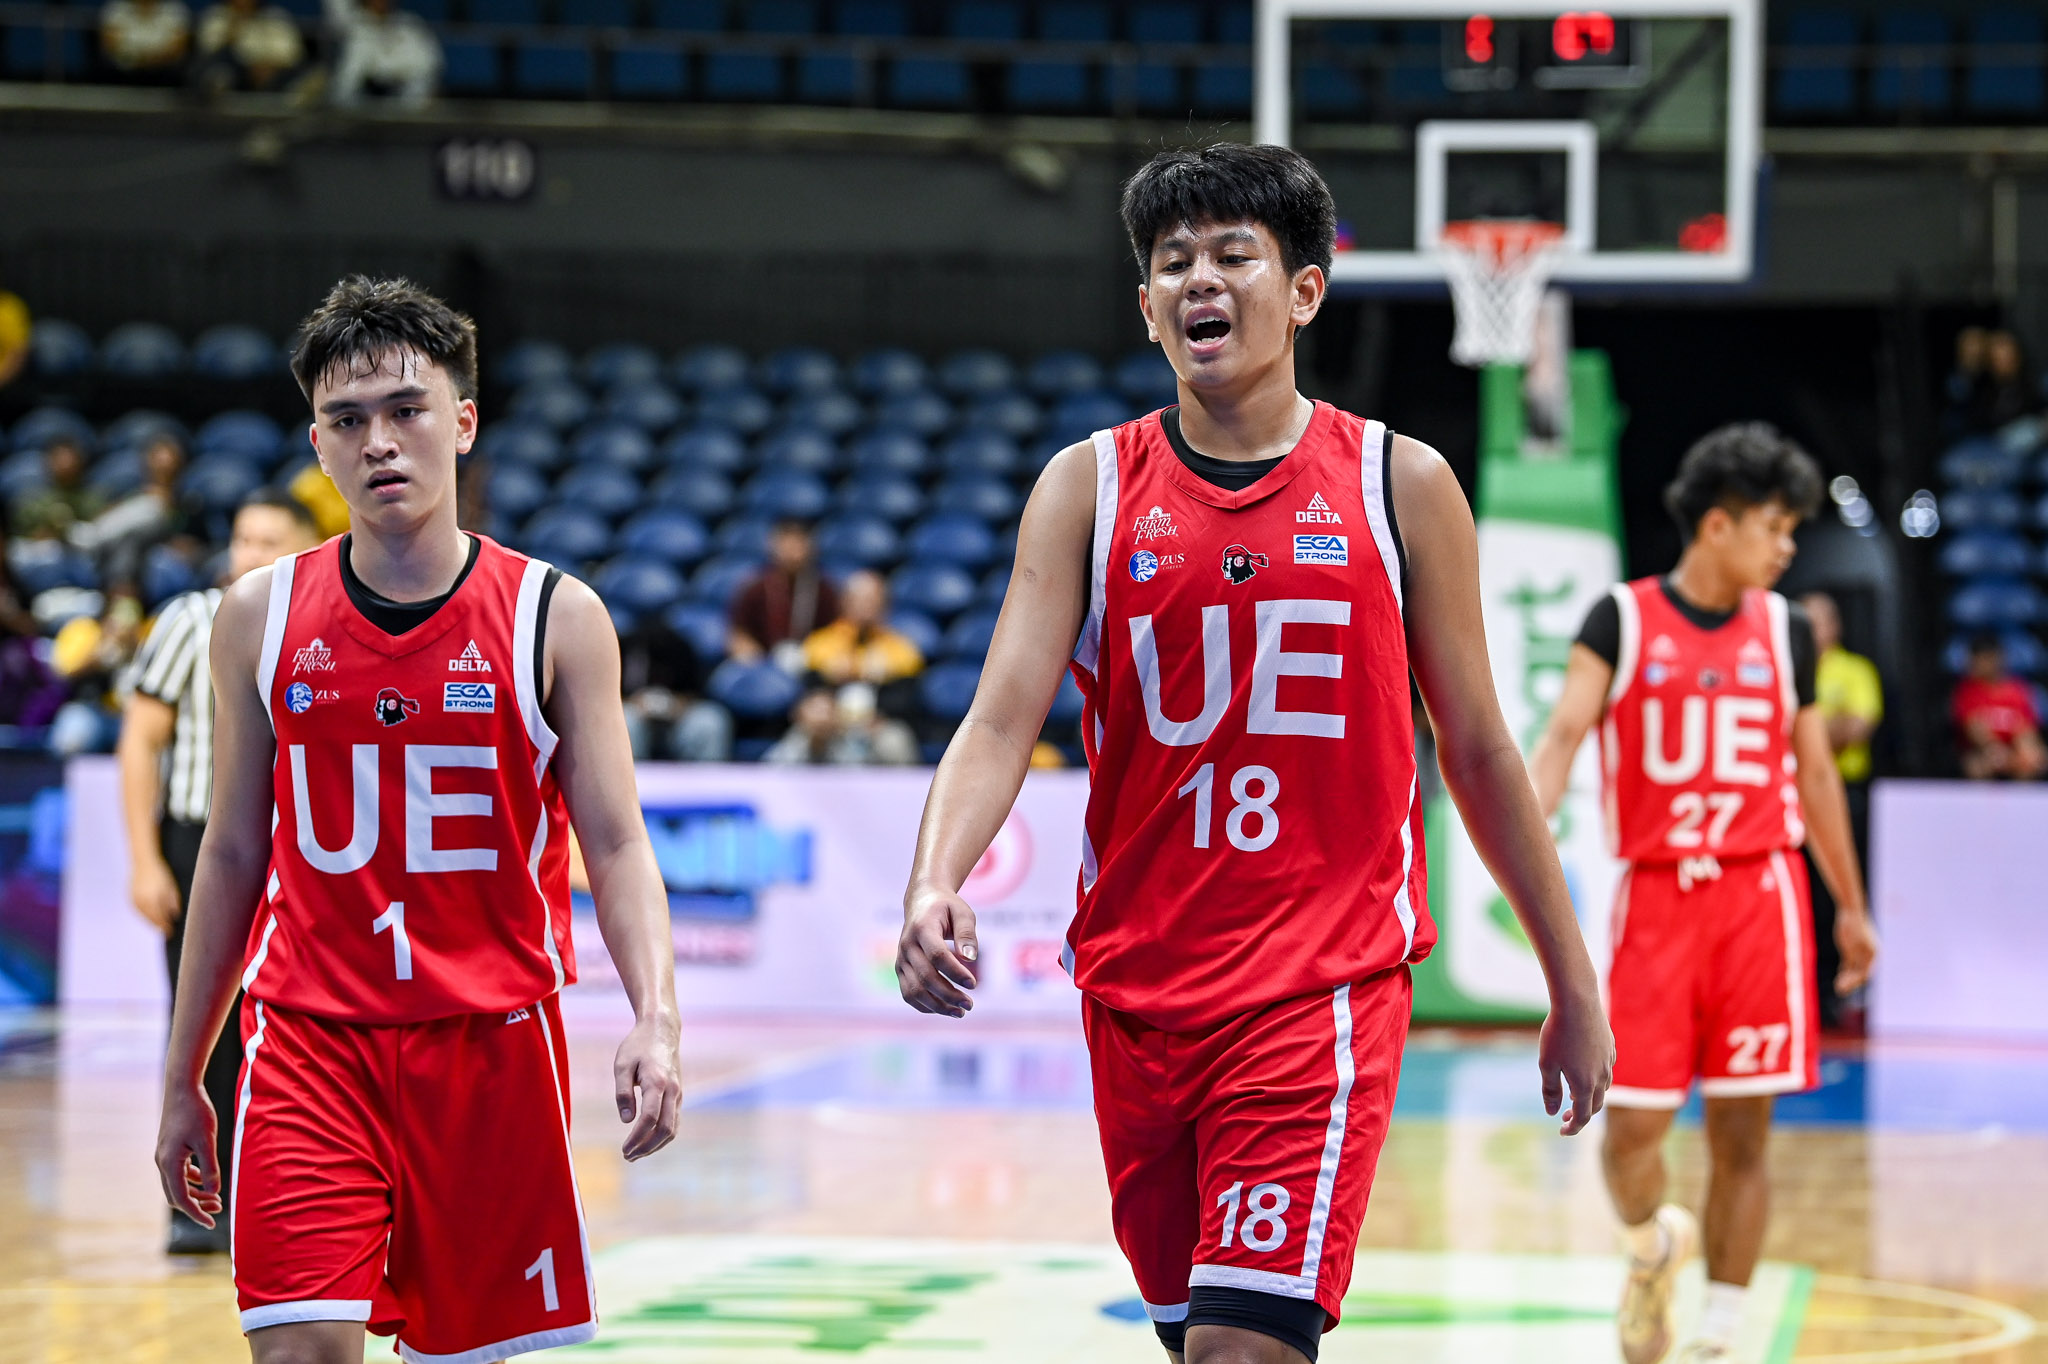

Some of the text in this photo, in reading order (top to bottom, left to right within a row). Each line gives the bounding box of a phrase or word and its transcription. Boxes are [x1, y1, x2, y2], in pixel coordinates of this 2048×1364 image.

[1295, 511, 1343, 524] DELTA
[1296, 536, 1346, 551] SGA
[1160, 553, 1185, 566] ZUS
[1296, 552, 1347, 561] STRONG
[446, 684, 492, 698] SGA
[448, 659, 492, 672] DELTA
[1129, 600, 1351, 746] UE
[315, 690, 340, 699] ZUS
[445, 700, 493, 708] STRONG
[1642, 695, 1774, 787] UE
[289, 744, 498, 874] UE
[1178, 763, 1280, 851] 18
[1667, 791, 1744, 848] 27
[373, 901, 413, 980] 1
[1726, 1022, 1789, 1075] 27
[1216, 1181, 1291, 1252] 18
[525, 1247, 560, 1312] 1
